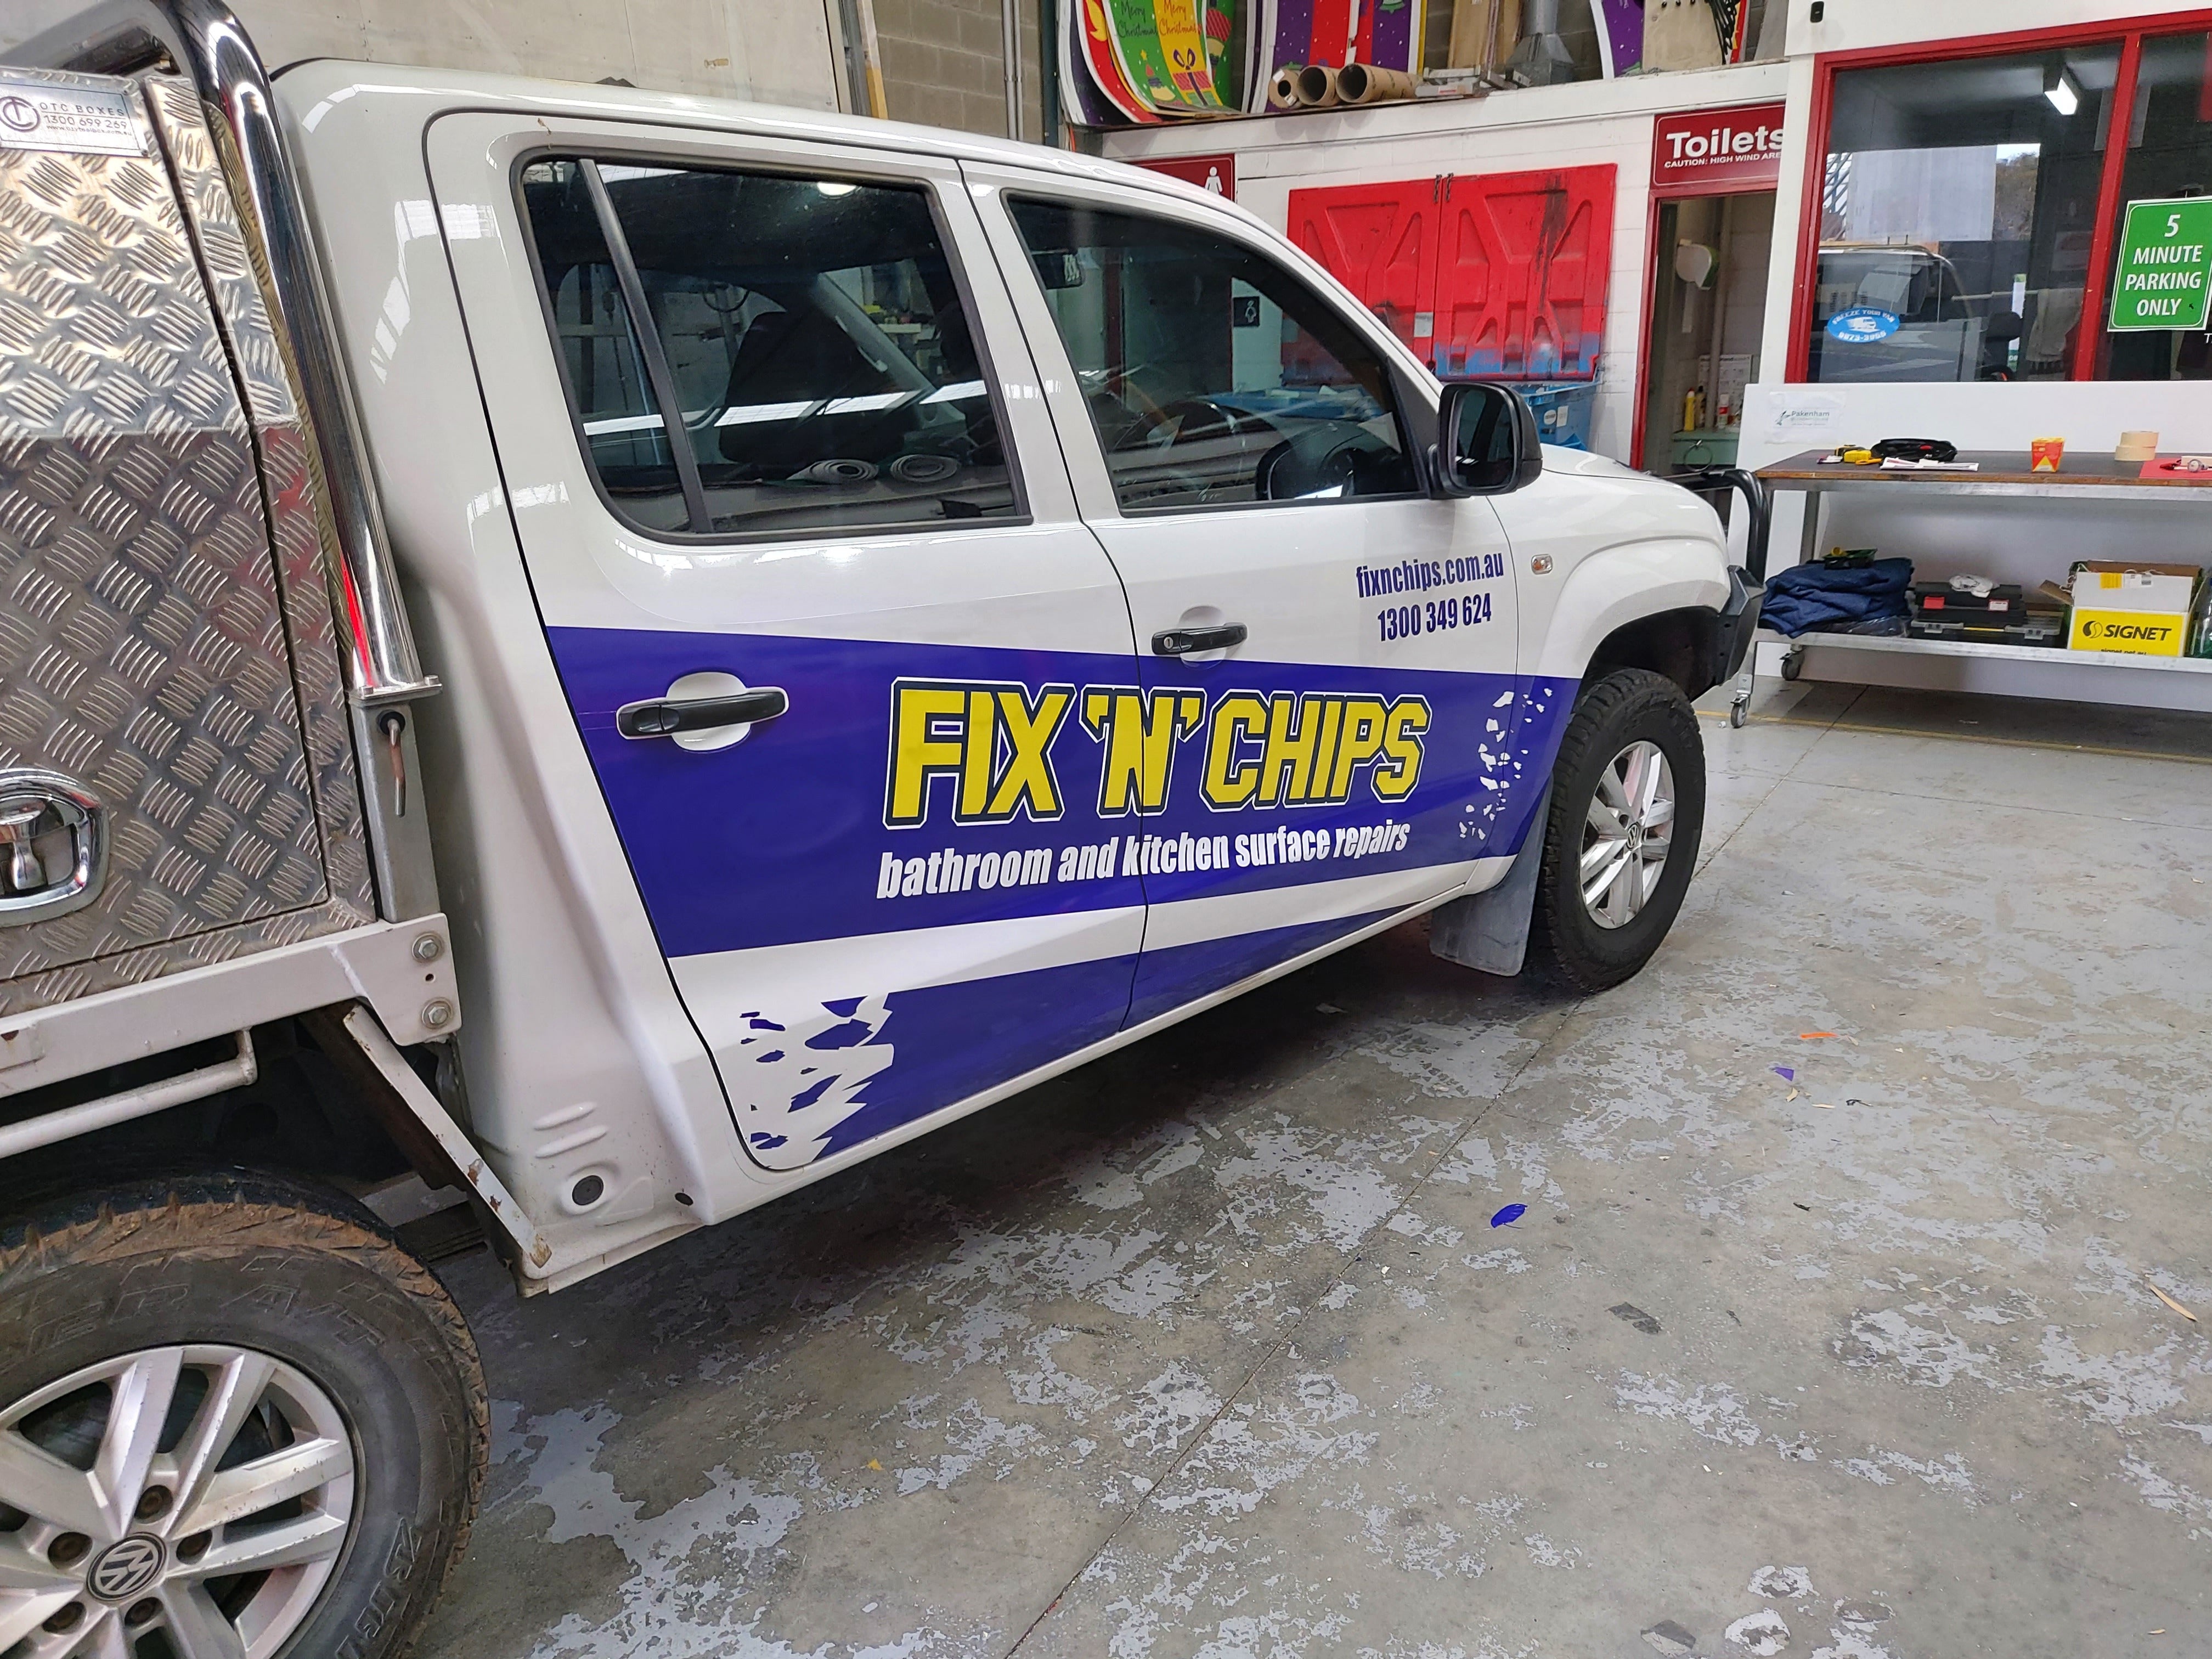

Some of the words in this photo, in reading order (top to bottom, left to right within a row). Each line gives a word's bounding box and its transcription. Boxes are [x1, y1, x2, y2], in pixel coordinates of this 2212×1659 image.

[1121, 0, 1146, 22] Merry
[1163, 0, 1187, 20] Merry
[40, 102, 68, 111] OTC
[75, 105, 125, 116] BOXES
[43, 115, 75, 126] 1300
[79, 117, 101, 127] 699
[106, 119, 127, 129] 269
[1666, 126, 1784, 159] Toilets
[1664, 159, 1708, 168] CAUTION:
[1709, 155, 1734, 164] HIGH
[1735, 153, 1760, 162] WIND
[1761, 151, 1782, 160] ARE
[2164, 214, 2181, 238] 5
[2132, 245, 2203, 265] MINUTE
[2125, 272, 2202, 291] PARKING
[2136, 298, 2182, 317] ONLY
[1356, 552, 1504, 598] fixnchips.com.au
[1378, 604, 1421, 641] 1300
[1426, 598, 1458, 633] 349
[1462, 592, 1492, 626] 624
[2103, 624, 2172, 641] SIGNET
[883, 676, 1077, 830] FIX
[1199, 689, 1432, 812] CHIPS
[876, 847, 1053, 899] bathroom
[1057, 836, 1120, 883] and
[1122, 831, 1229, 877] kitchen
[1234, 825, 1331, 868] surface
[1333, 819, 1410, 860] repairs
